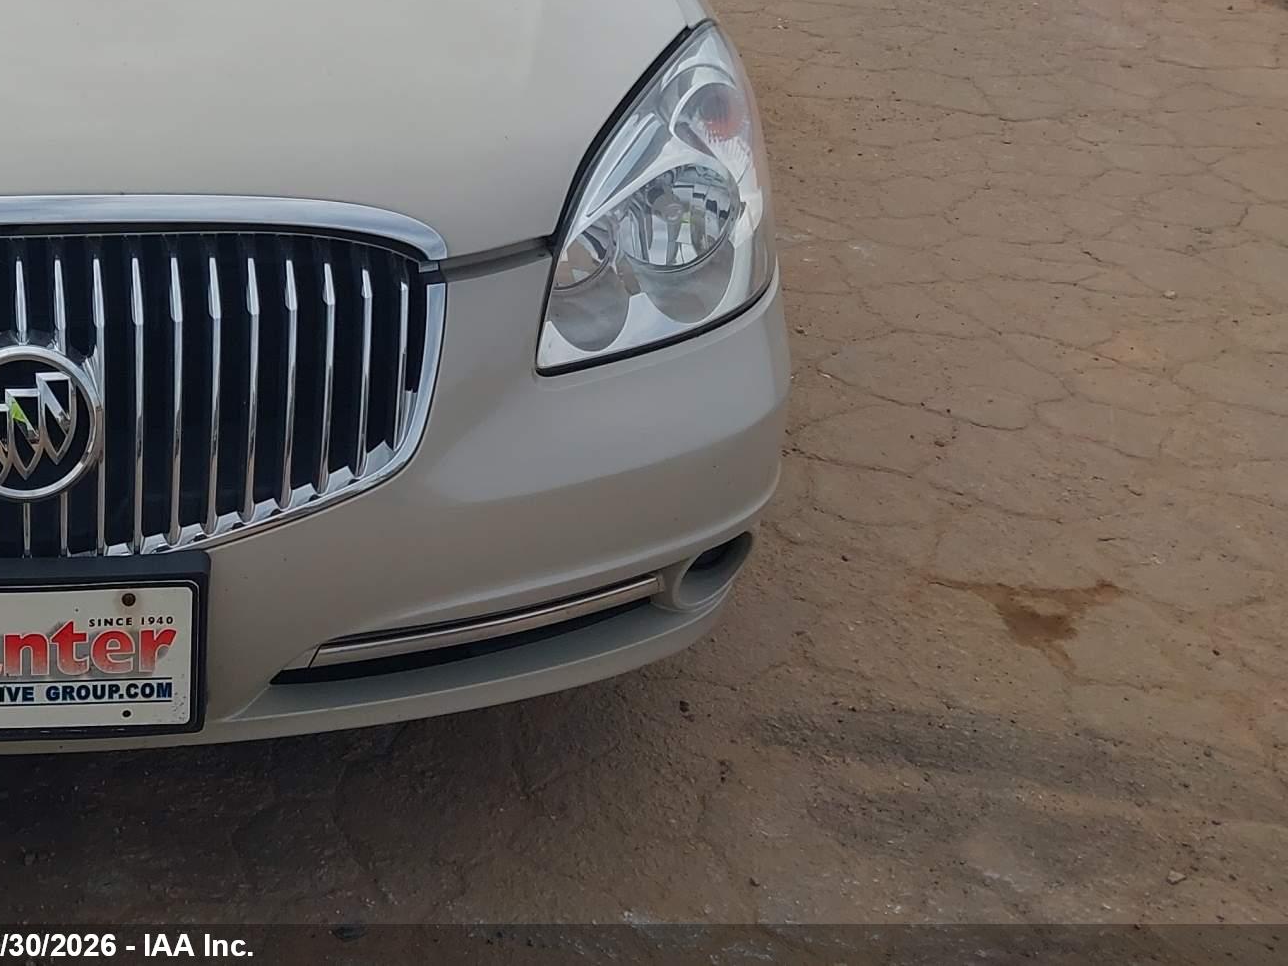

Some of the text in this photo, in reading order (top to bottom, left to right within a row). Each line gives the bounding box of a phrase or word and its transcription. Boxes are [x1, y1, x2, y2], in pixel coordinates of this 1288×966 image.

[88, 615, 174, 628] SINCE 1940
[45, 682, 173, 702] GROUP.COM
